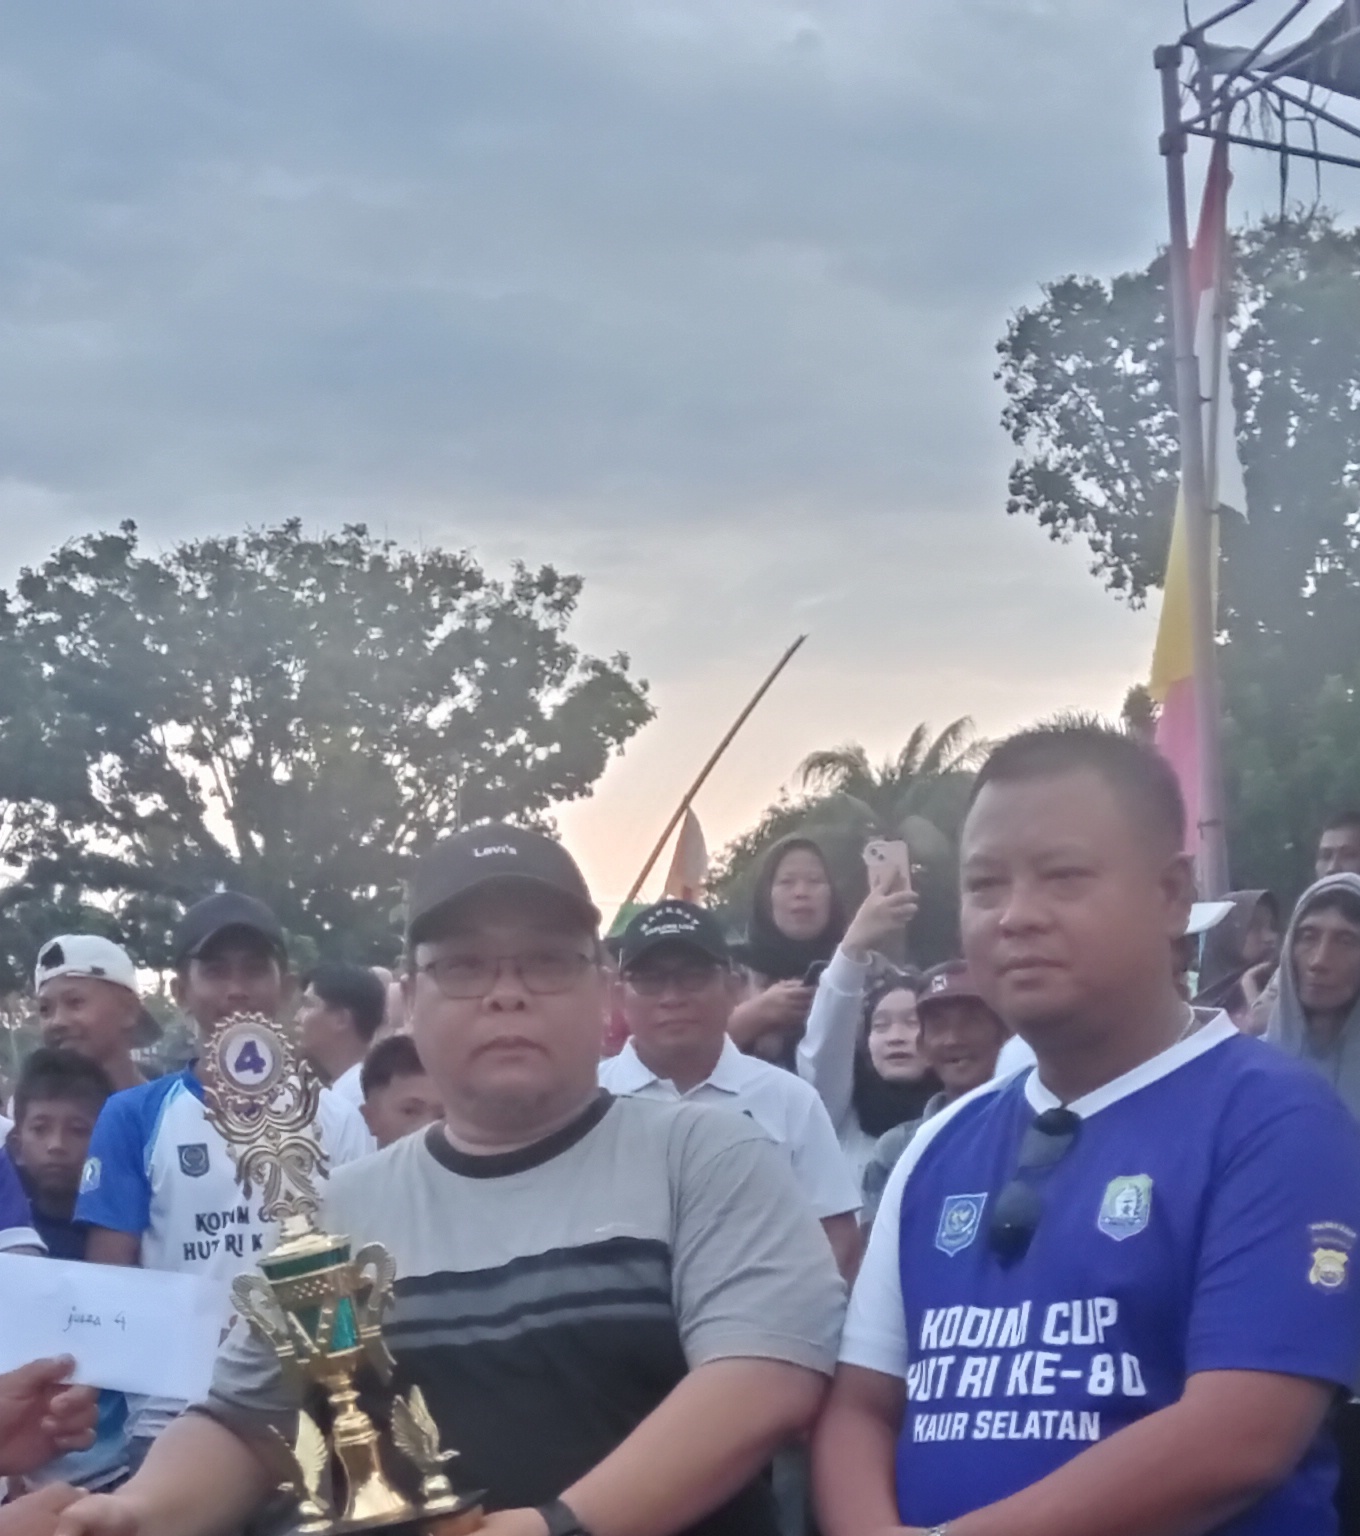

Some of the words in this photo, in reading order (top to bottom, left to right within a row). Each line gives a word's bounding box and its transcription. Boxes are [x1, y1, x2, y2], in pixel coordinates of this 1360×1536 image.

[234, 1040, 266, 1075] 4
[225, 1234, 243, 1258] RI
[920, 1300, 1032, 1351] KODIM
[1042, 1297, 1119, 1345] CUP
[907, 1354, 956, 1402] HUT
[956, 1354, 1002, 1398] RI
[1005, 1350, 1148, 1397] KE-80
[913, 1412, 970, 1443] KAUR
[972, 1409, 1101, 1442] SELATAN
